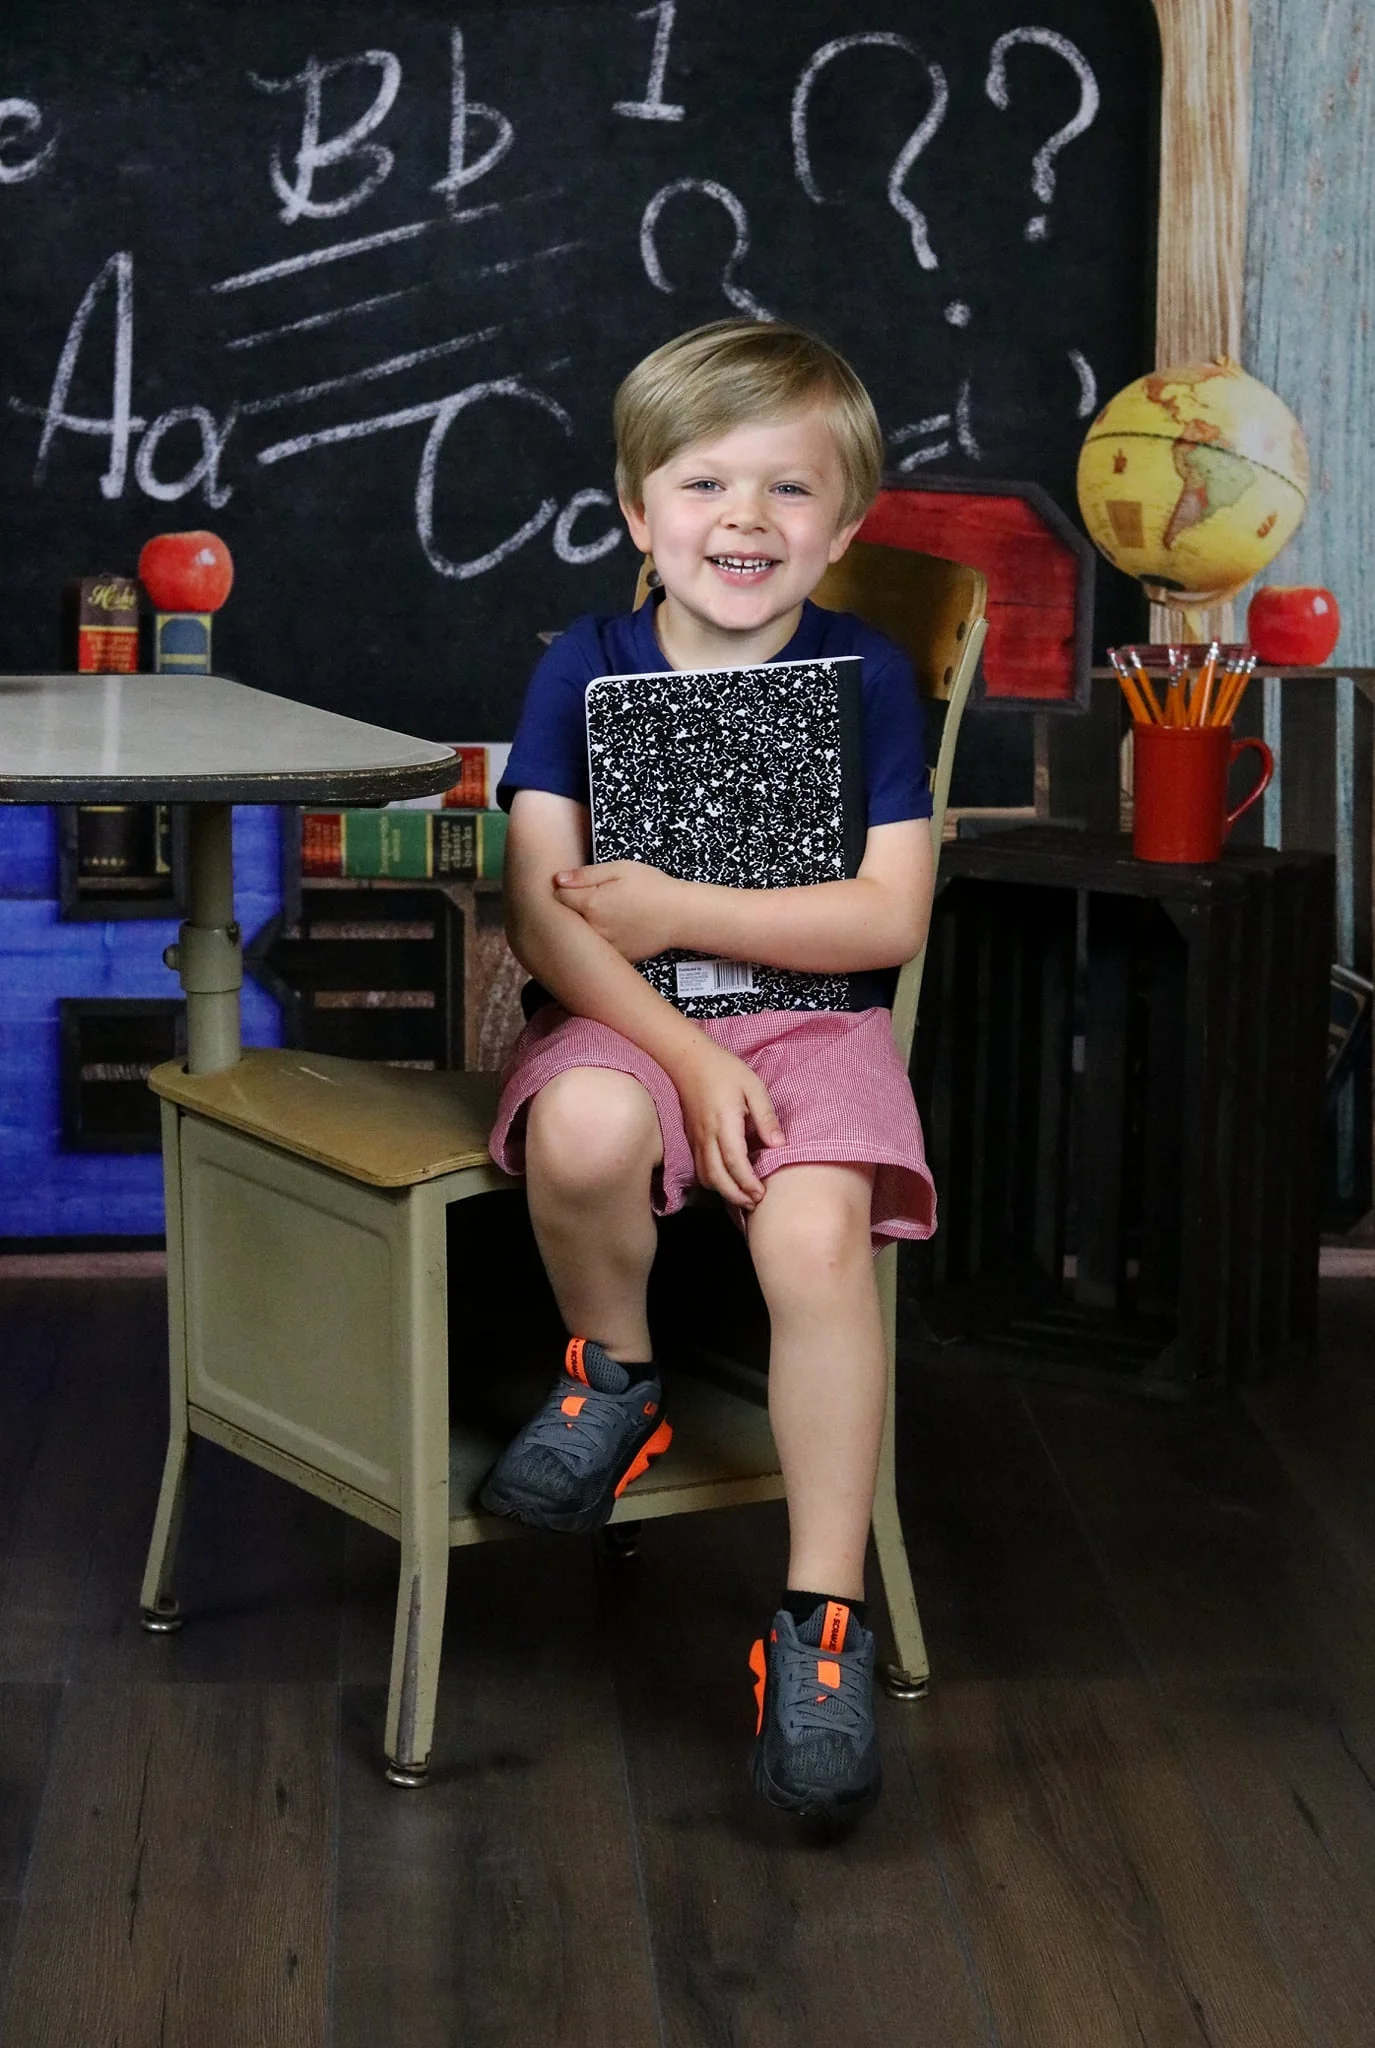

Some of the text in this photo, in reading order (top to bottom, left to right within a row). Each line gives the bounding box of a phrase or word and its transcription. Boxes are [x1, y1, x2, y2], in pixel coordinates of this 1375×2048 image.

[612, 0, 685, 121] 1
[439, 820, 451, 872] Empire
[451, 825, 461, 868] classic
[462, 825, 473, 867] books
